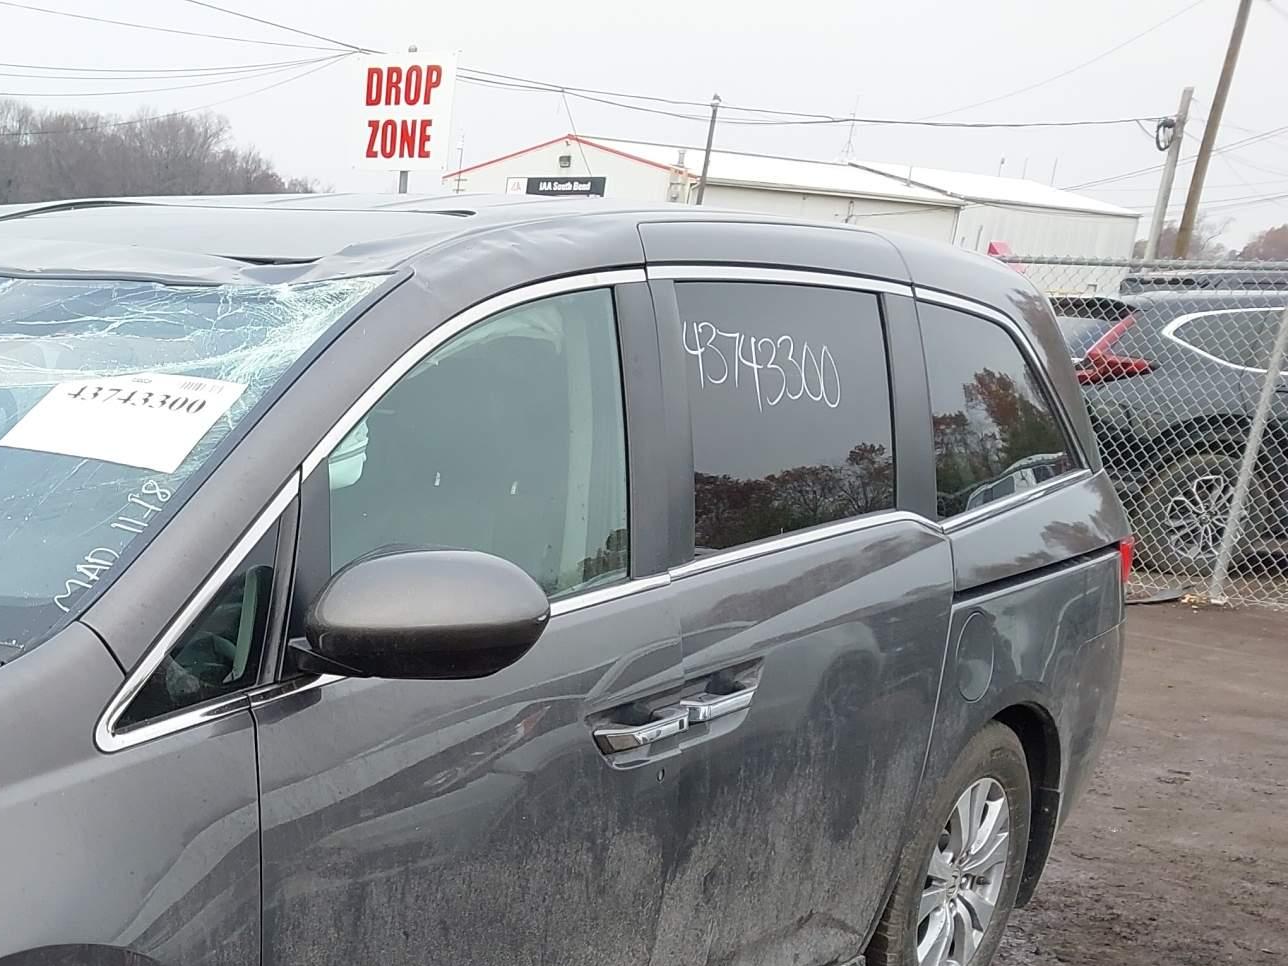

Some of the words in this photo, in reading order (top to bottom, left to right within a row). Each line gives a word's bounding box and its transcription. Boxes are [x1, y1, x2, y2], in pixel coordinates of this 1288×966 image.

[365, 64, 442, 106] DROP
[365, 119, 432, 158] ZONE
[539, 181, 552, 191] IAA
[553, 181, 572, 191] South
[573, 181, 591, 191] Bend
[682, 320, 841, 412] 43743300
[67, 384, 207, 414] 43743300
[54, 547, 120, 612] MAD
[110, 479, 171, 534] 11-18
